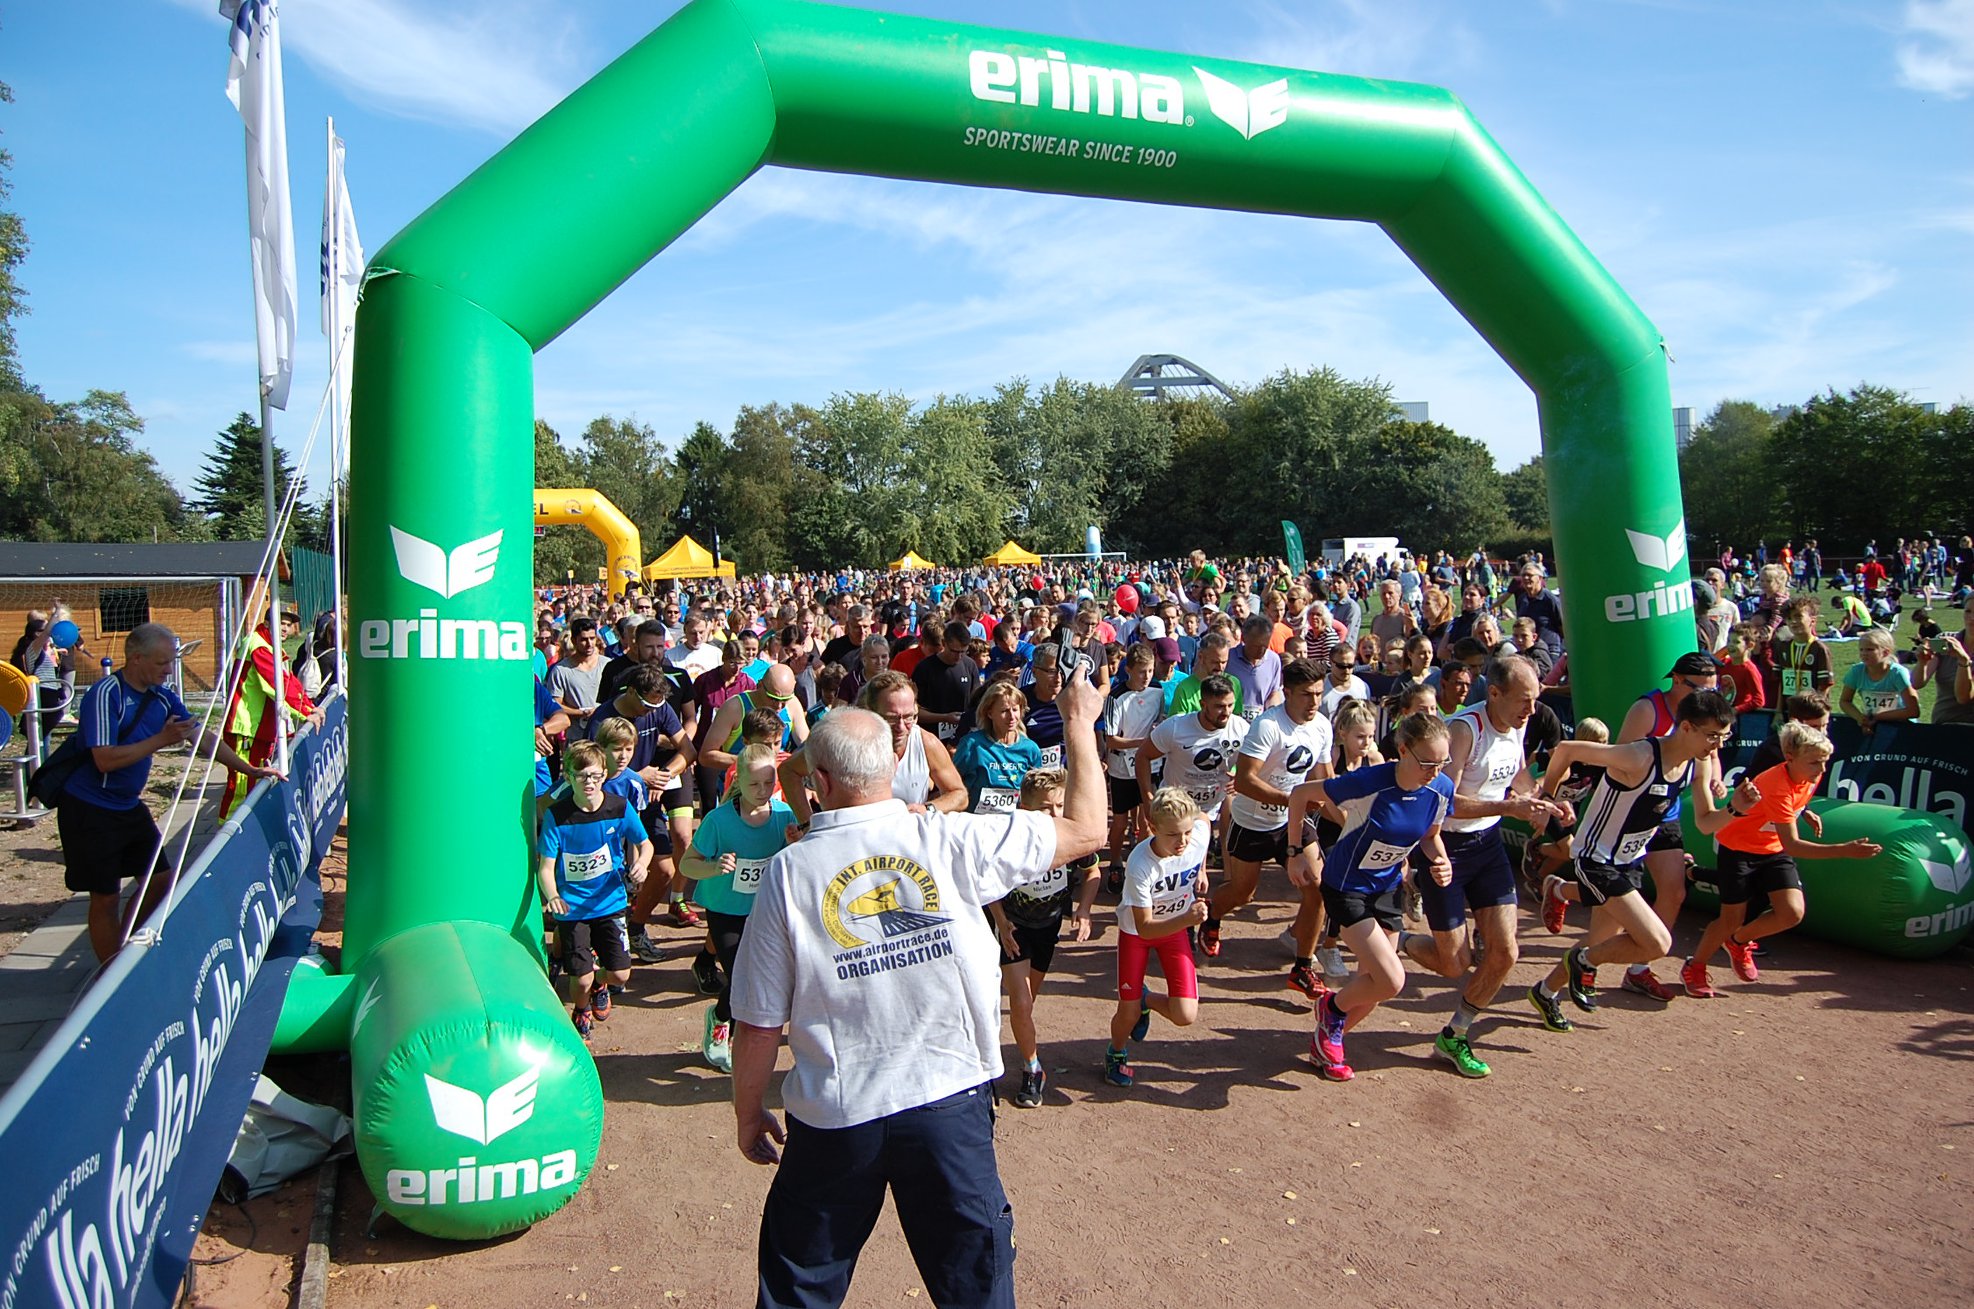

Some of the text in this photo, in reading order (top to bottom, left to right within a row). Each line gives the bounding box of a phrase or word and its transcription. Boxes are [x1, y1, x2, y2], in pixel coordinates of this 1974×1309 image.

[968, 50, 1185, 125] erima
[963, 126, 1178, 169] SPORTSWEAR SINCE 1900
[360, 608, 530, 660] erima
[1785, 676, 1809, 688] 273
[1865, 696, 1894, 708] 2147
[1851, 754, 1968, 776] VON GRUND AUF FRISCH
[983, 795, 1015, 807] 5360
[1827, 760, 1966, 830] hella
[569, 855, 607, 873] 5323
[740, 866, 766, 882] 53
[836, 857, 938, 908] INT. AIRPORT RACE
[1150, 873, 1179, 893] SV
[1152, 899, 1186, 915] 249
[832, 927, 949, 963] www.airportrace.de
[836, 940, 954, 981] ORGANISATION
[165, 1020, 185, 1042] FRISCH
[108, 1055, 189, 1289] hella
[387, 1149, 577, 1206] erima
[14, 1207, 48, 1275] GRUND
[51, 1178, 69, 1216] AUF
[71, 1152, 100, 1191] FRISCH
